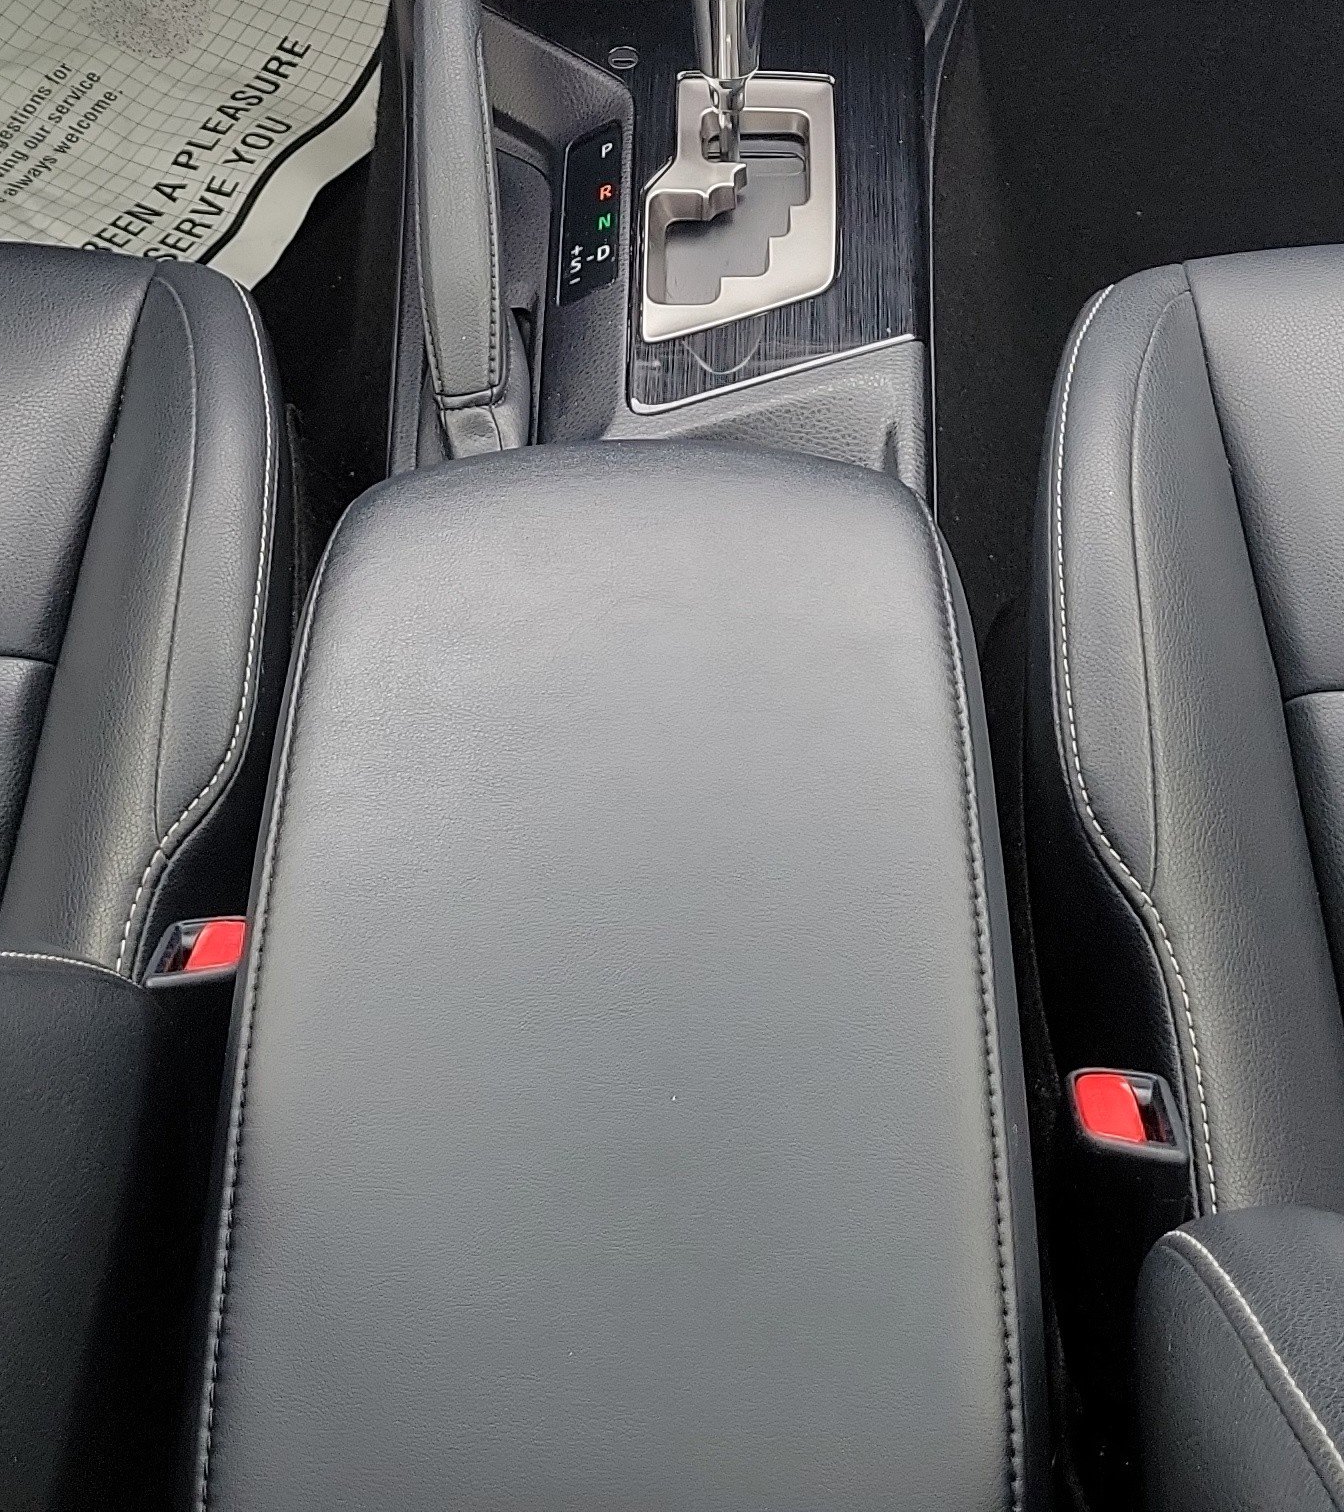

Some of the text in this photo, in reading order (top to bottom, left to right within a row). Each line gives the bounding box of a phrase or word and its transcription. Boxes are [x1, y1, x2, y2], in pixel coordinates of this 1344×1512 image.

[44, 61, 73, 85] for
[23, 123, 52, 151] our
[47, 70, 102, 124] service
[153, 181, 188, 203] A
[171, 35, 313, 171] PLEASURE
[222, 115, 294, 165] YOU
[601, 142, 613, 159] P
[4, 154, 58, 197] always
[599, 184, 612, 201] R
[597, 214, 612, 231] N
[570, 245, 611, 274] S D
